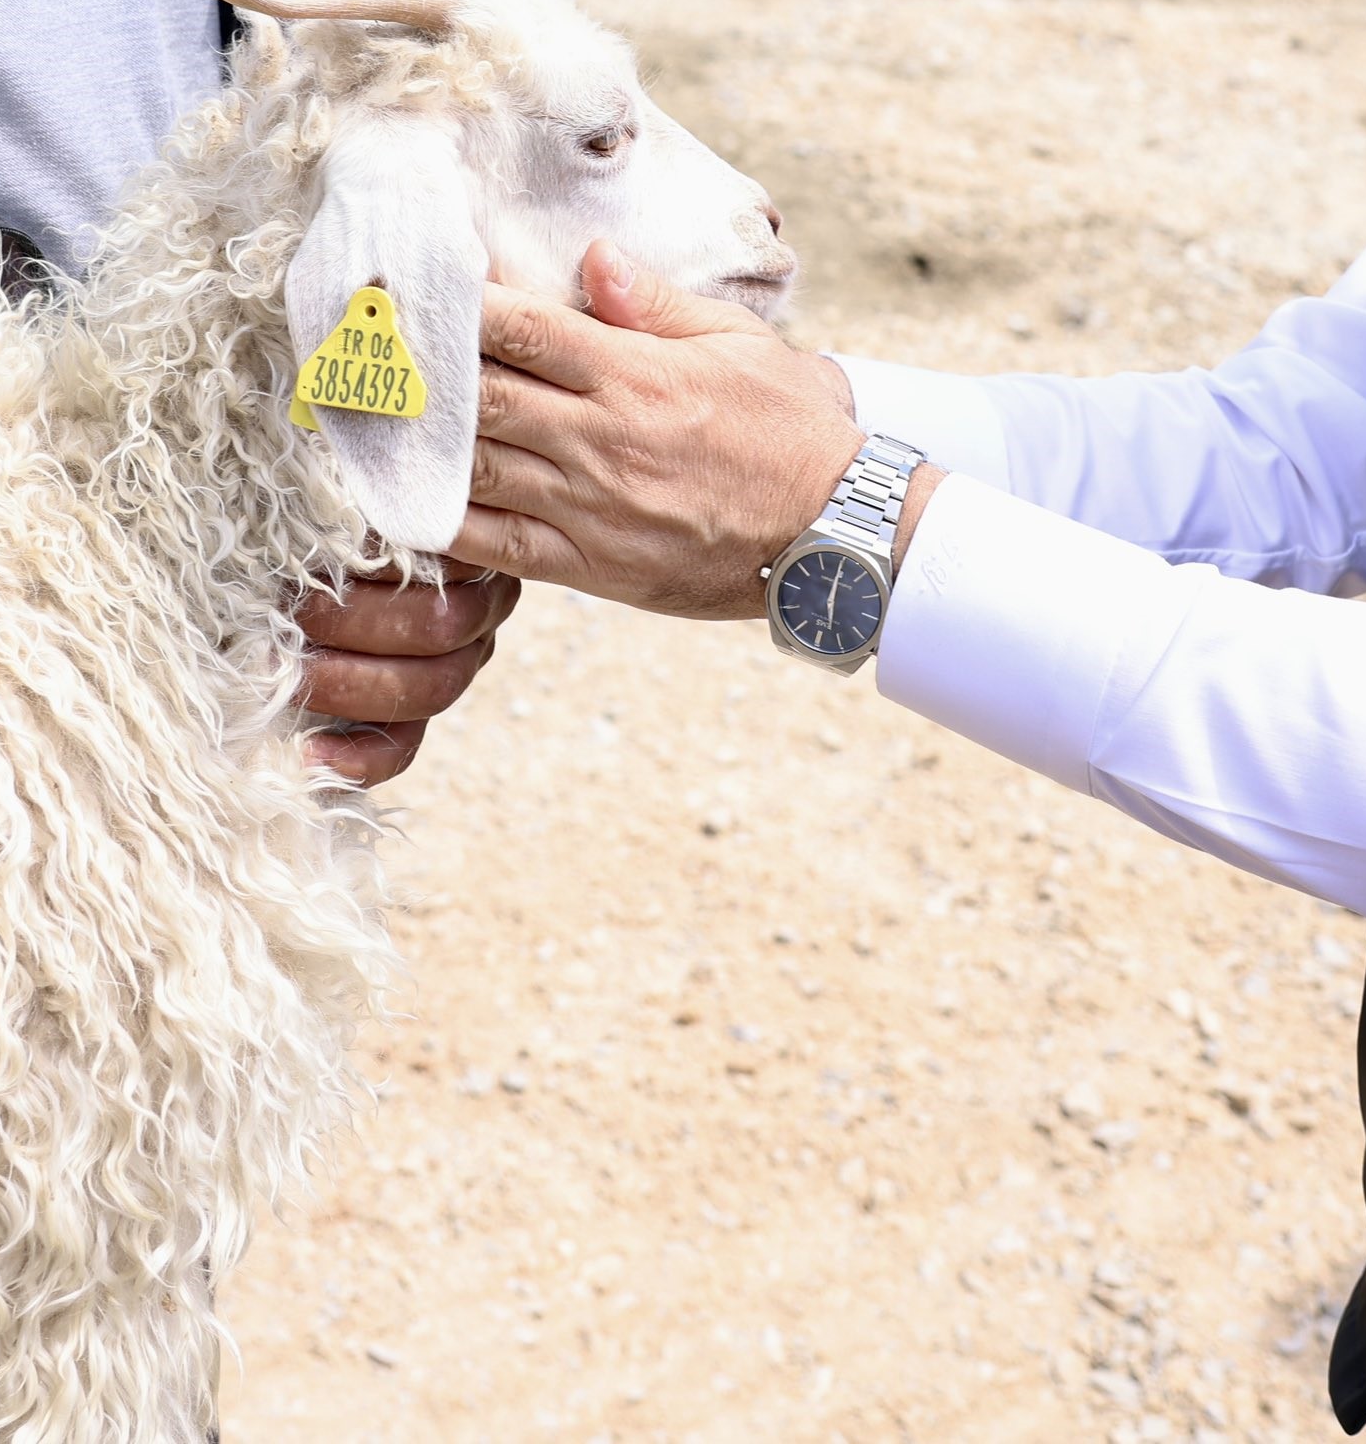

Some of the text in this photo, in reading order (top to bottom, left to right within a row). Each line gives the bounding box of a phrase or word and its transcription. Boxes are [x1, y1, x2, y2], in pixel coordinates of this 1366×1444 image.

[343, 328, 393, 361] TR 06
[311, 355, 410, 412] 3854393
